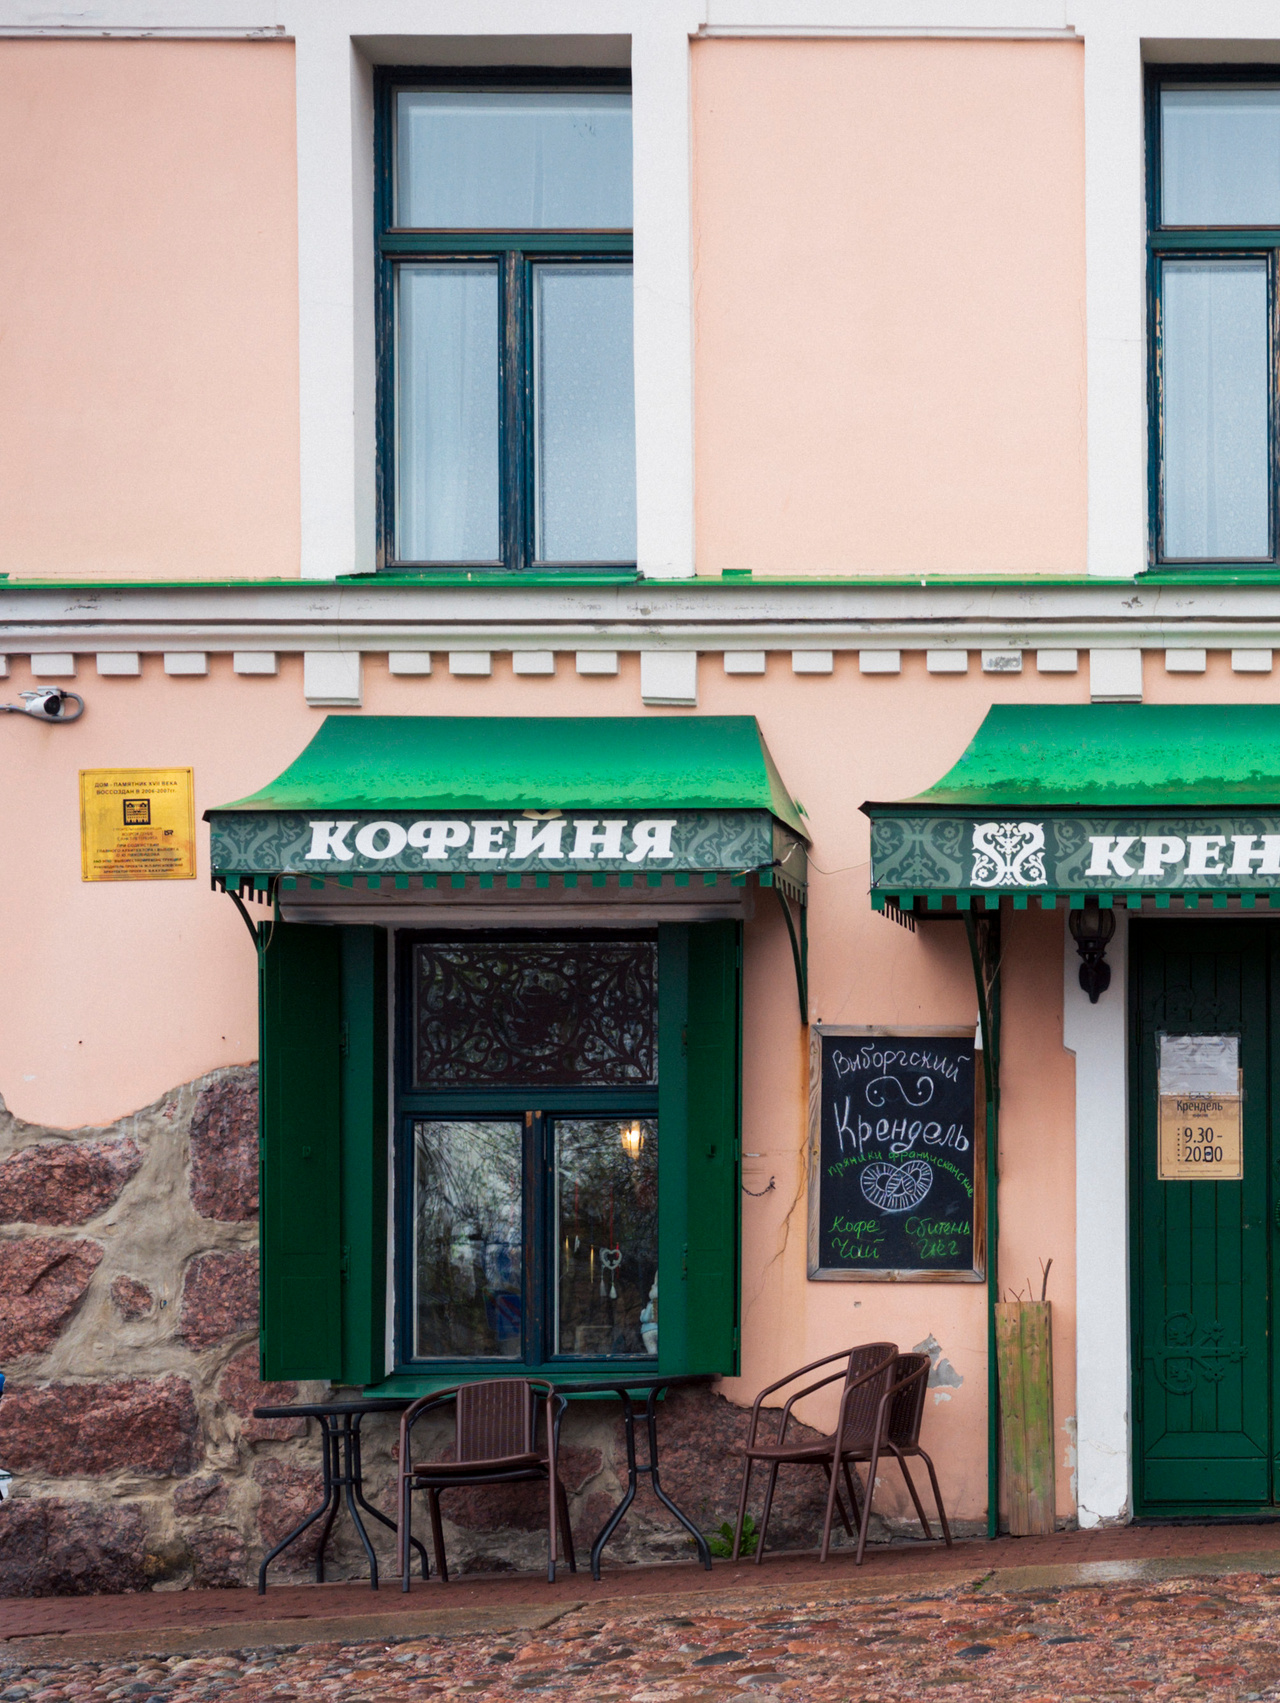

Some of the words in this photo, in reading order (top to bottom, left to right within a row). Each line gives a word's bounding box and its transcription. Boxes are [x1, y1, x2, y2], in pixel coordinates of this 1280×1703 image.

[305, 810, 677, 863] КОФЕЙНЯ
[832, 1043, 970, 1082] Выборгский
[1176, 1100, 1223, 1114] Крендель
[834, 1094, 970, 1153] Крендель
[1184, 1127, 1214, 1143] 9.30
[828, 1151, 882, 1177] пряники
[829, 1215, 880, 1239] Кофе
[905, 1216, 970, 1238] Сбитень
[831, 1238, 884, 1259] Чай
